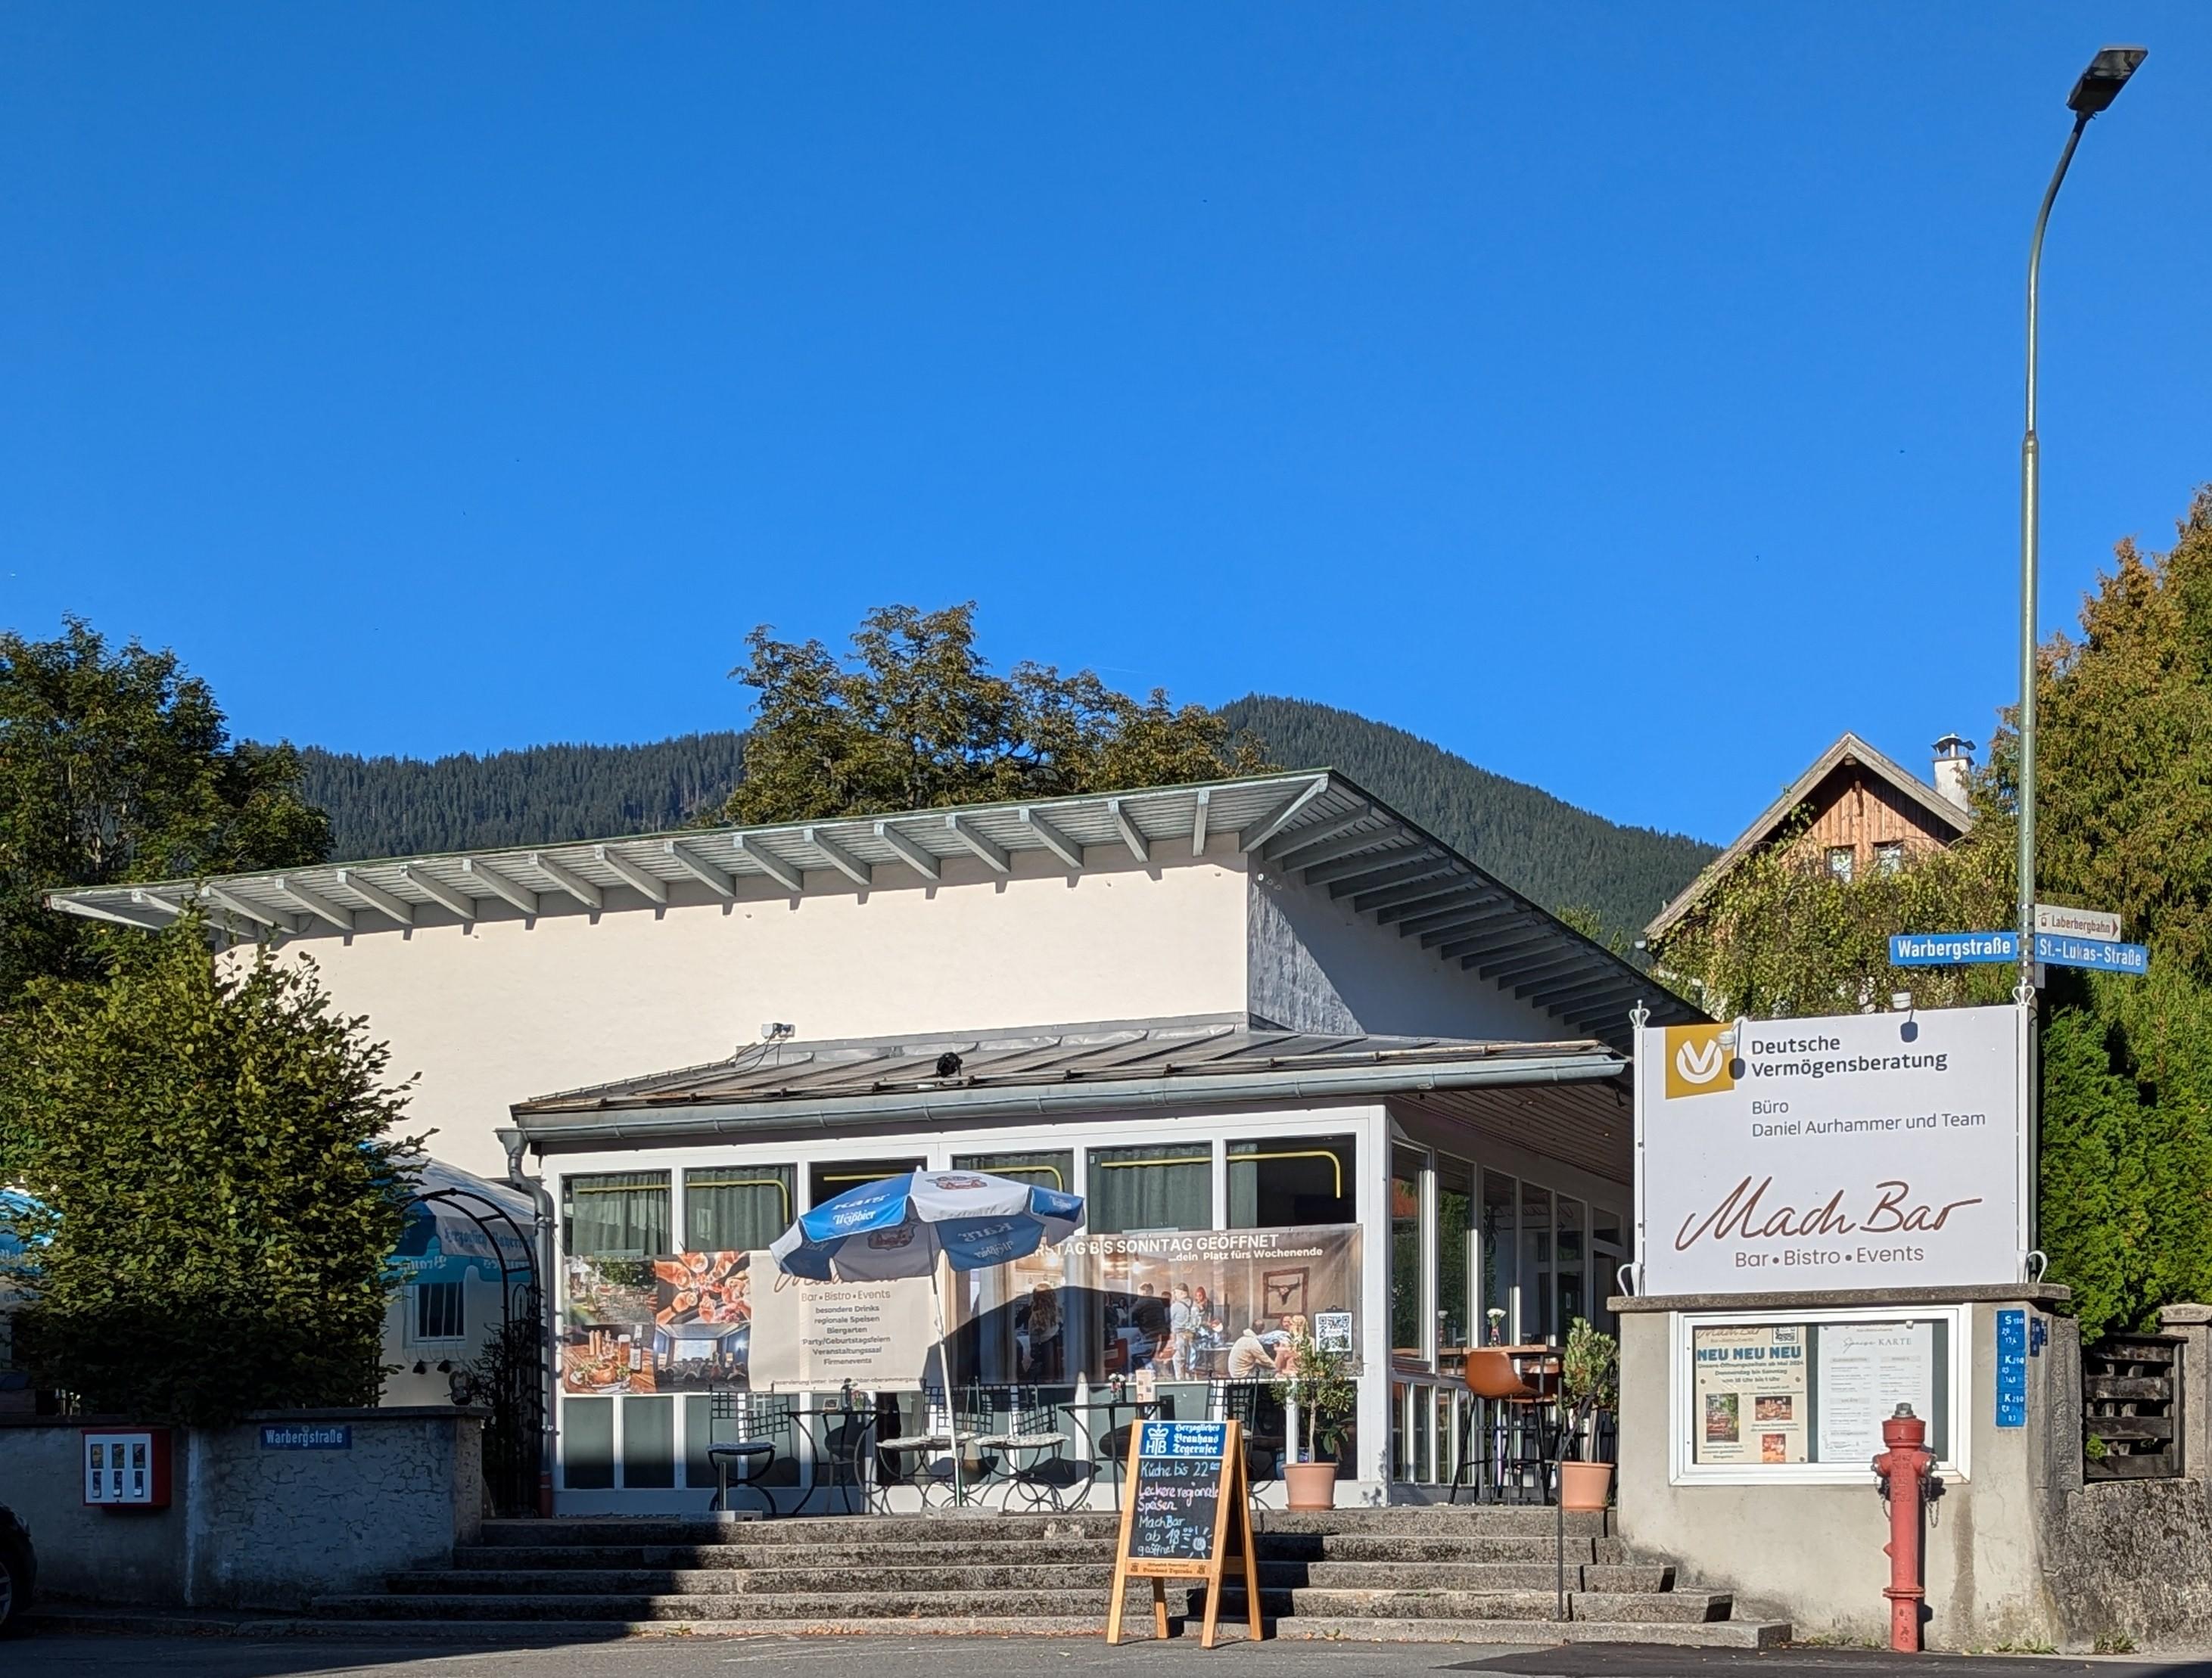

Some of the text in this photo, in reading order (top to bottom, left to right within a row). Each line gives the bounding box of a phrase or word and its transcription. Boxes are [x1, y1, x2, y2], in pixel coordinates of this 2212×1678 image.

[2052, 915, 2111, 934] Laberbergbahn
[1897, 937, 2011, 960] Warbergstraße
[2039, 938, 2142, 967] St.-Lukas-Straße
[1751, 1036, 1840, 1055] Deutsche
[1751, 1053, 1948, 1079] Vermögensberatung
[1752, 1099, 1789, 1115] Büro
[1752, 1113, 1986, 1137] Daniel Aurhammer und Team
[833, 1209, 876, 1226] Weißbier
[1675, 1175, 1983, 1251] Mach Bar
[1116, 1238, 1193, 1254] SONNTAG
[1196, 1232, 1279, 1251] GEÖFFNET
[1203, 1251, 1230, 1261] Platz
[1230, 1250, 1252, 1260] fürs
[1253, 1248, 1323, 1259] Wochenende
[1734, 1245, 1924, 1267] Bar Bistro Events
[801, 1289, 891, 1302] Bar Bistro Events
[815, 1304, 880, 1314] besondere Drinks
[814, 1315, 880, 1325] regionale Speisen
[2005, 1316, 2012, 1325] S
[826, 1326, 867, 1335] Biergarten
[802, 1335, 891, 1347] Party/Geburtstagsfeiern
[812, 1346, 882, 1356] Veranstaltungssaal
[1697, 1345, 1802, 1361] NEU NEU NEU
[823, 1357, 872, 1366] Firmenevents
[2005, 1355, 2012, 1364] K
[2004, 1393, 2011, 1403] K
[1174, 1424, 1220, 1434] Herzogliches
[265, 1428, 343, 1447] Warbergstraße
[1174, 1433, 1219, 1445] Brauhaus
[1172, 1443, 1218, 1455] Tegernsee
[1140, 1460, 1172, 1477] Küche
[1174, 1460, 1189, 1476] bis
[1138, 1479, 1218, 1507] Leckere regionale
[1137, 1496, 1178, 1515] Speisen
[1145, 1530, 1161, 1543] ab
[1137, 1543, 1175, 1556] geöffnet
